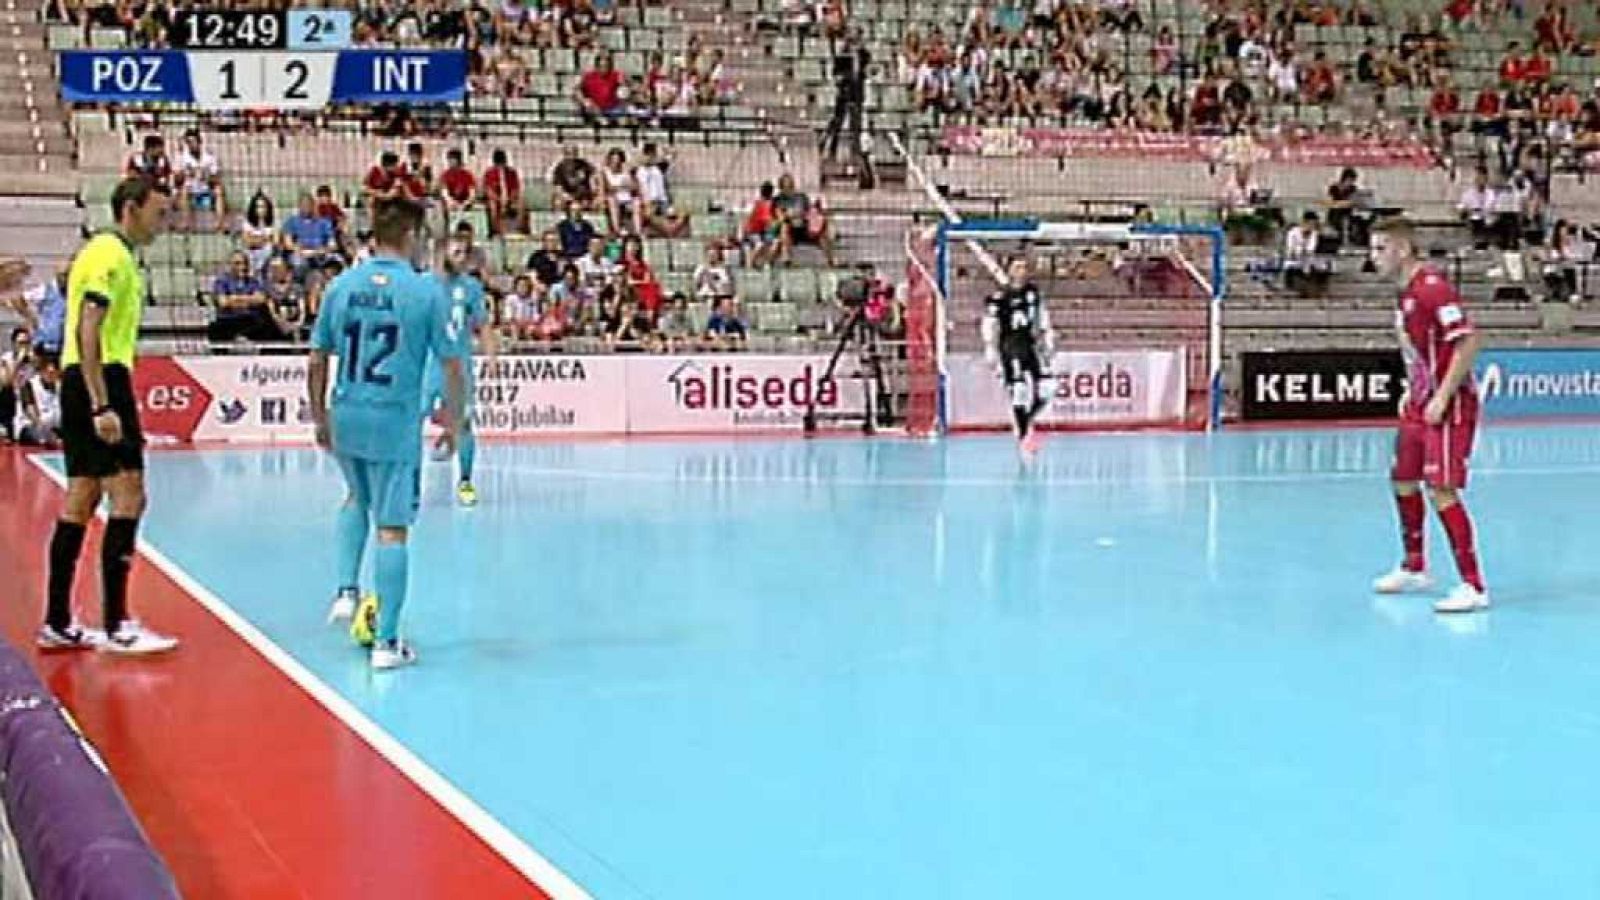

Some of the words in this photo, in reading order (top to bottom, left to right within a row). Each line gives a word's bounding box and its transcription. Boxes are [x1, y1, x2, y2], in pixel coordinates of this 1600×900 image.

[344, 320, 399, 386] 12
[474, 358, 586, 380] ARAVACA
[473, 384, 519, 404] 017
[683, 365, 838, 409] aliseda
[1256, 374, 1391, 402] KELME
